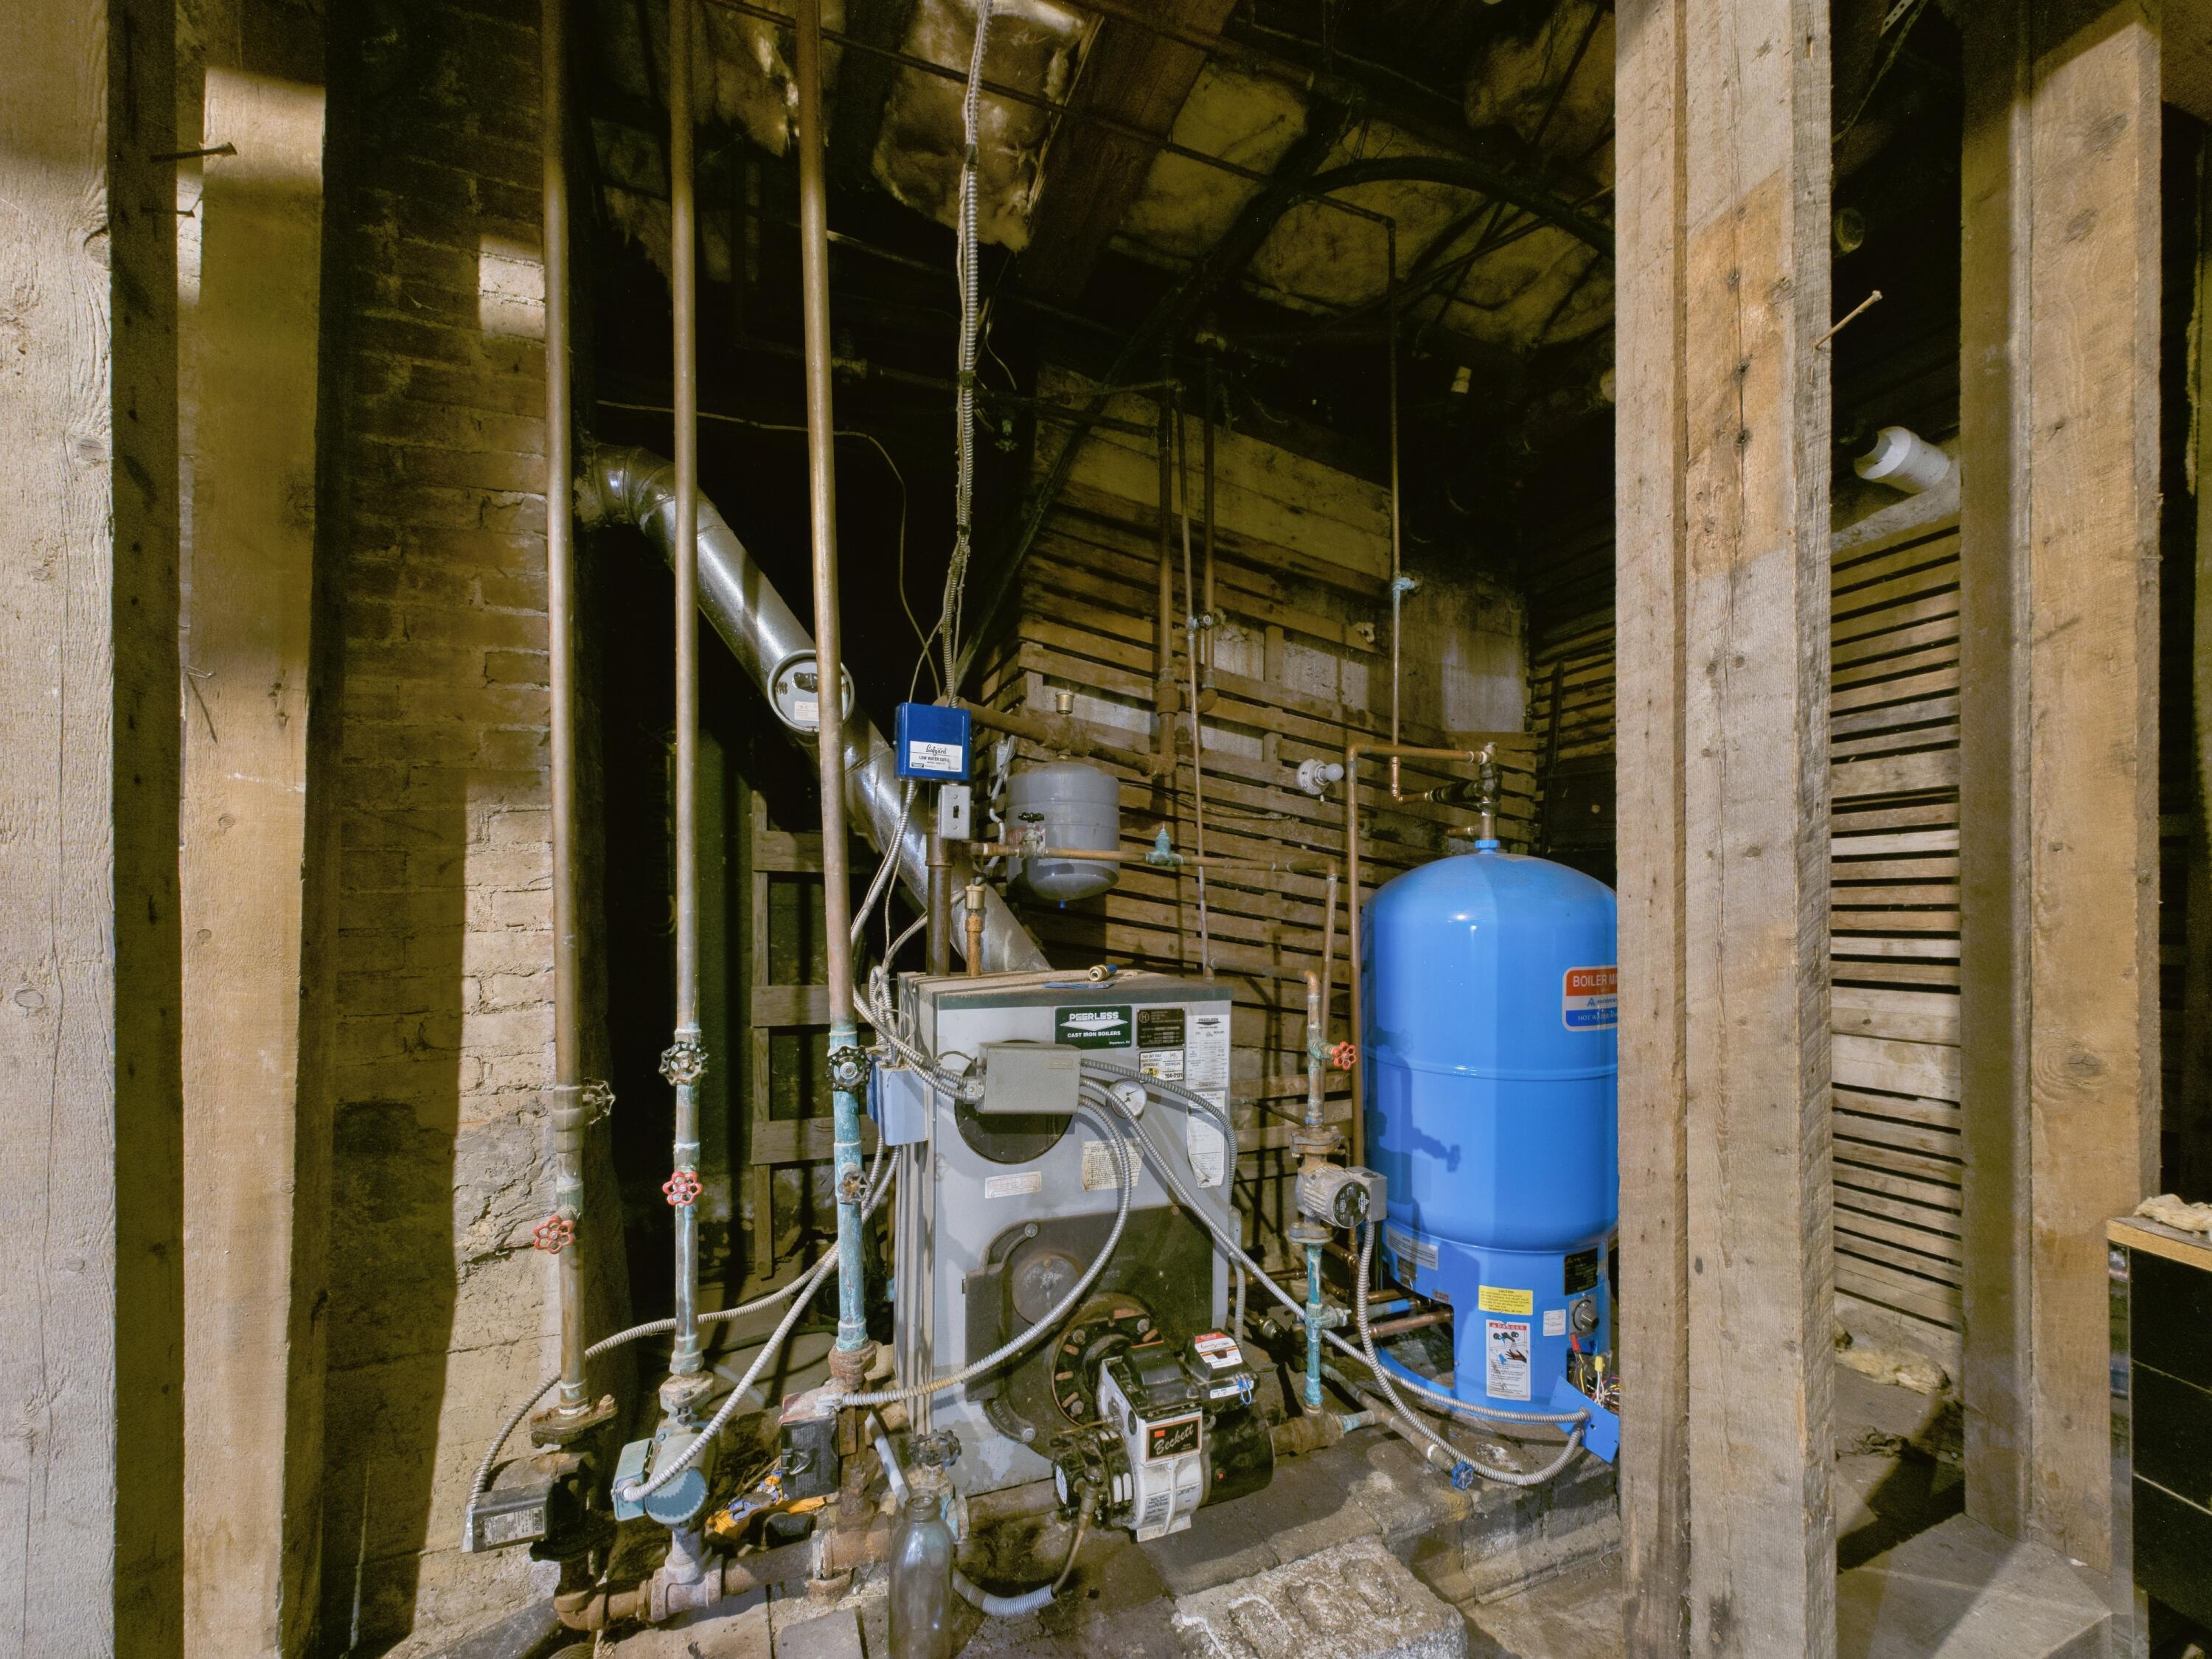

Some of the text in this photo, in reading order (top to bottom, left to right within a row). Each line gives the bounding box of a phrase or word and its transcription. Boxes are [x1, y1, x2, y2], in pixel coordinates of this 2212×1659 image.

[1573, 975, 1607, 987] BOILER
[1069, 1012, 1119, 1021] PEERLESS
[1154, 1424, 1193, 1455] Beckett
